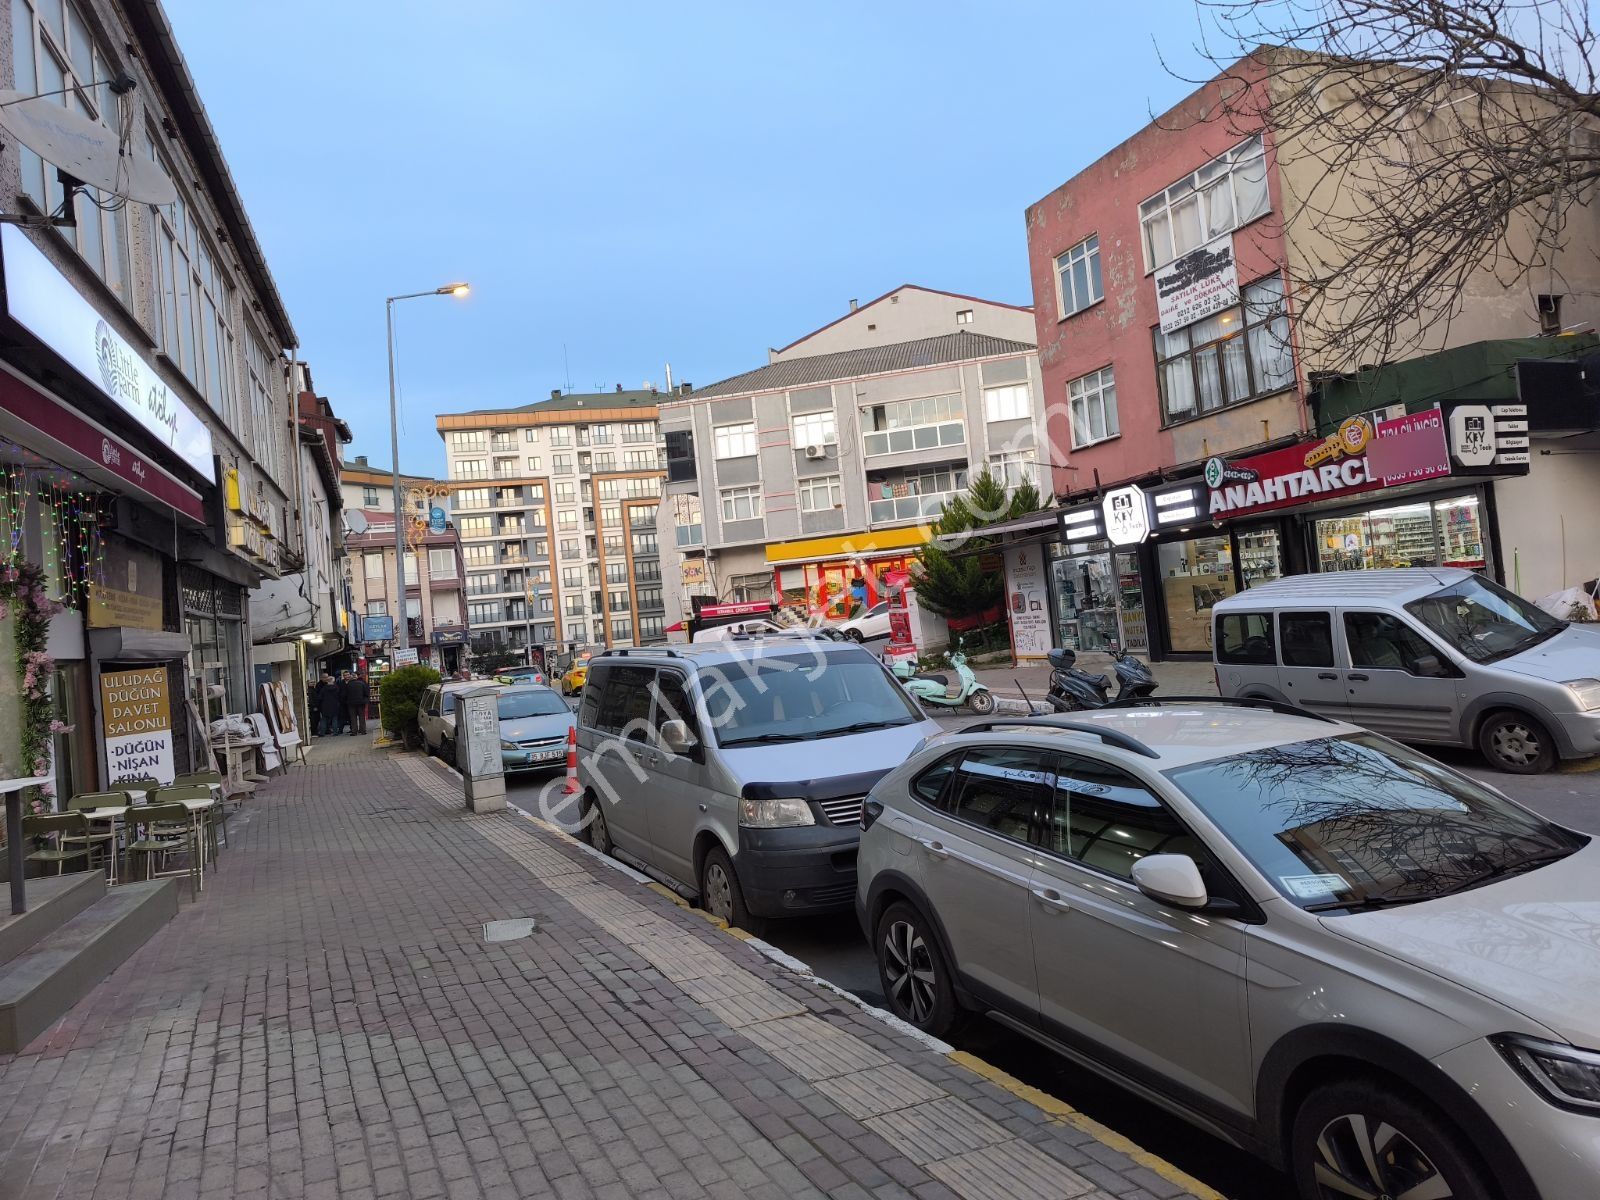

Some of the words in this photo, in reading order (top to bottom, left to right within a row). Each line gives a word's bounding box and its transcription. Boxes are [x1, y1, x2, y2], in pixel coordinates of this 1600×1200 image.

[1170, 284, 1198, 303] SATILIK
[115, 342, 139, 385] Little
[118, 372, 141, 405] Farm
[104, 671, 163, 689] ULUDAĞ
[109, 687, 161, 704] DÜĞÜN
[113, 702, 159, 719] DAVET
[108, 716, 167, 735] SALONU
